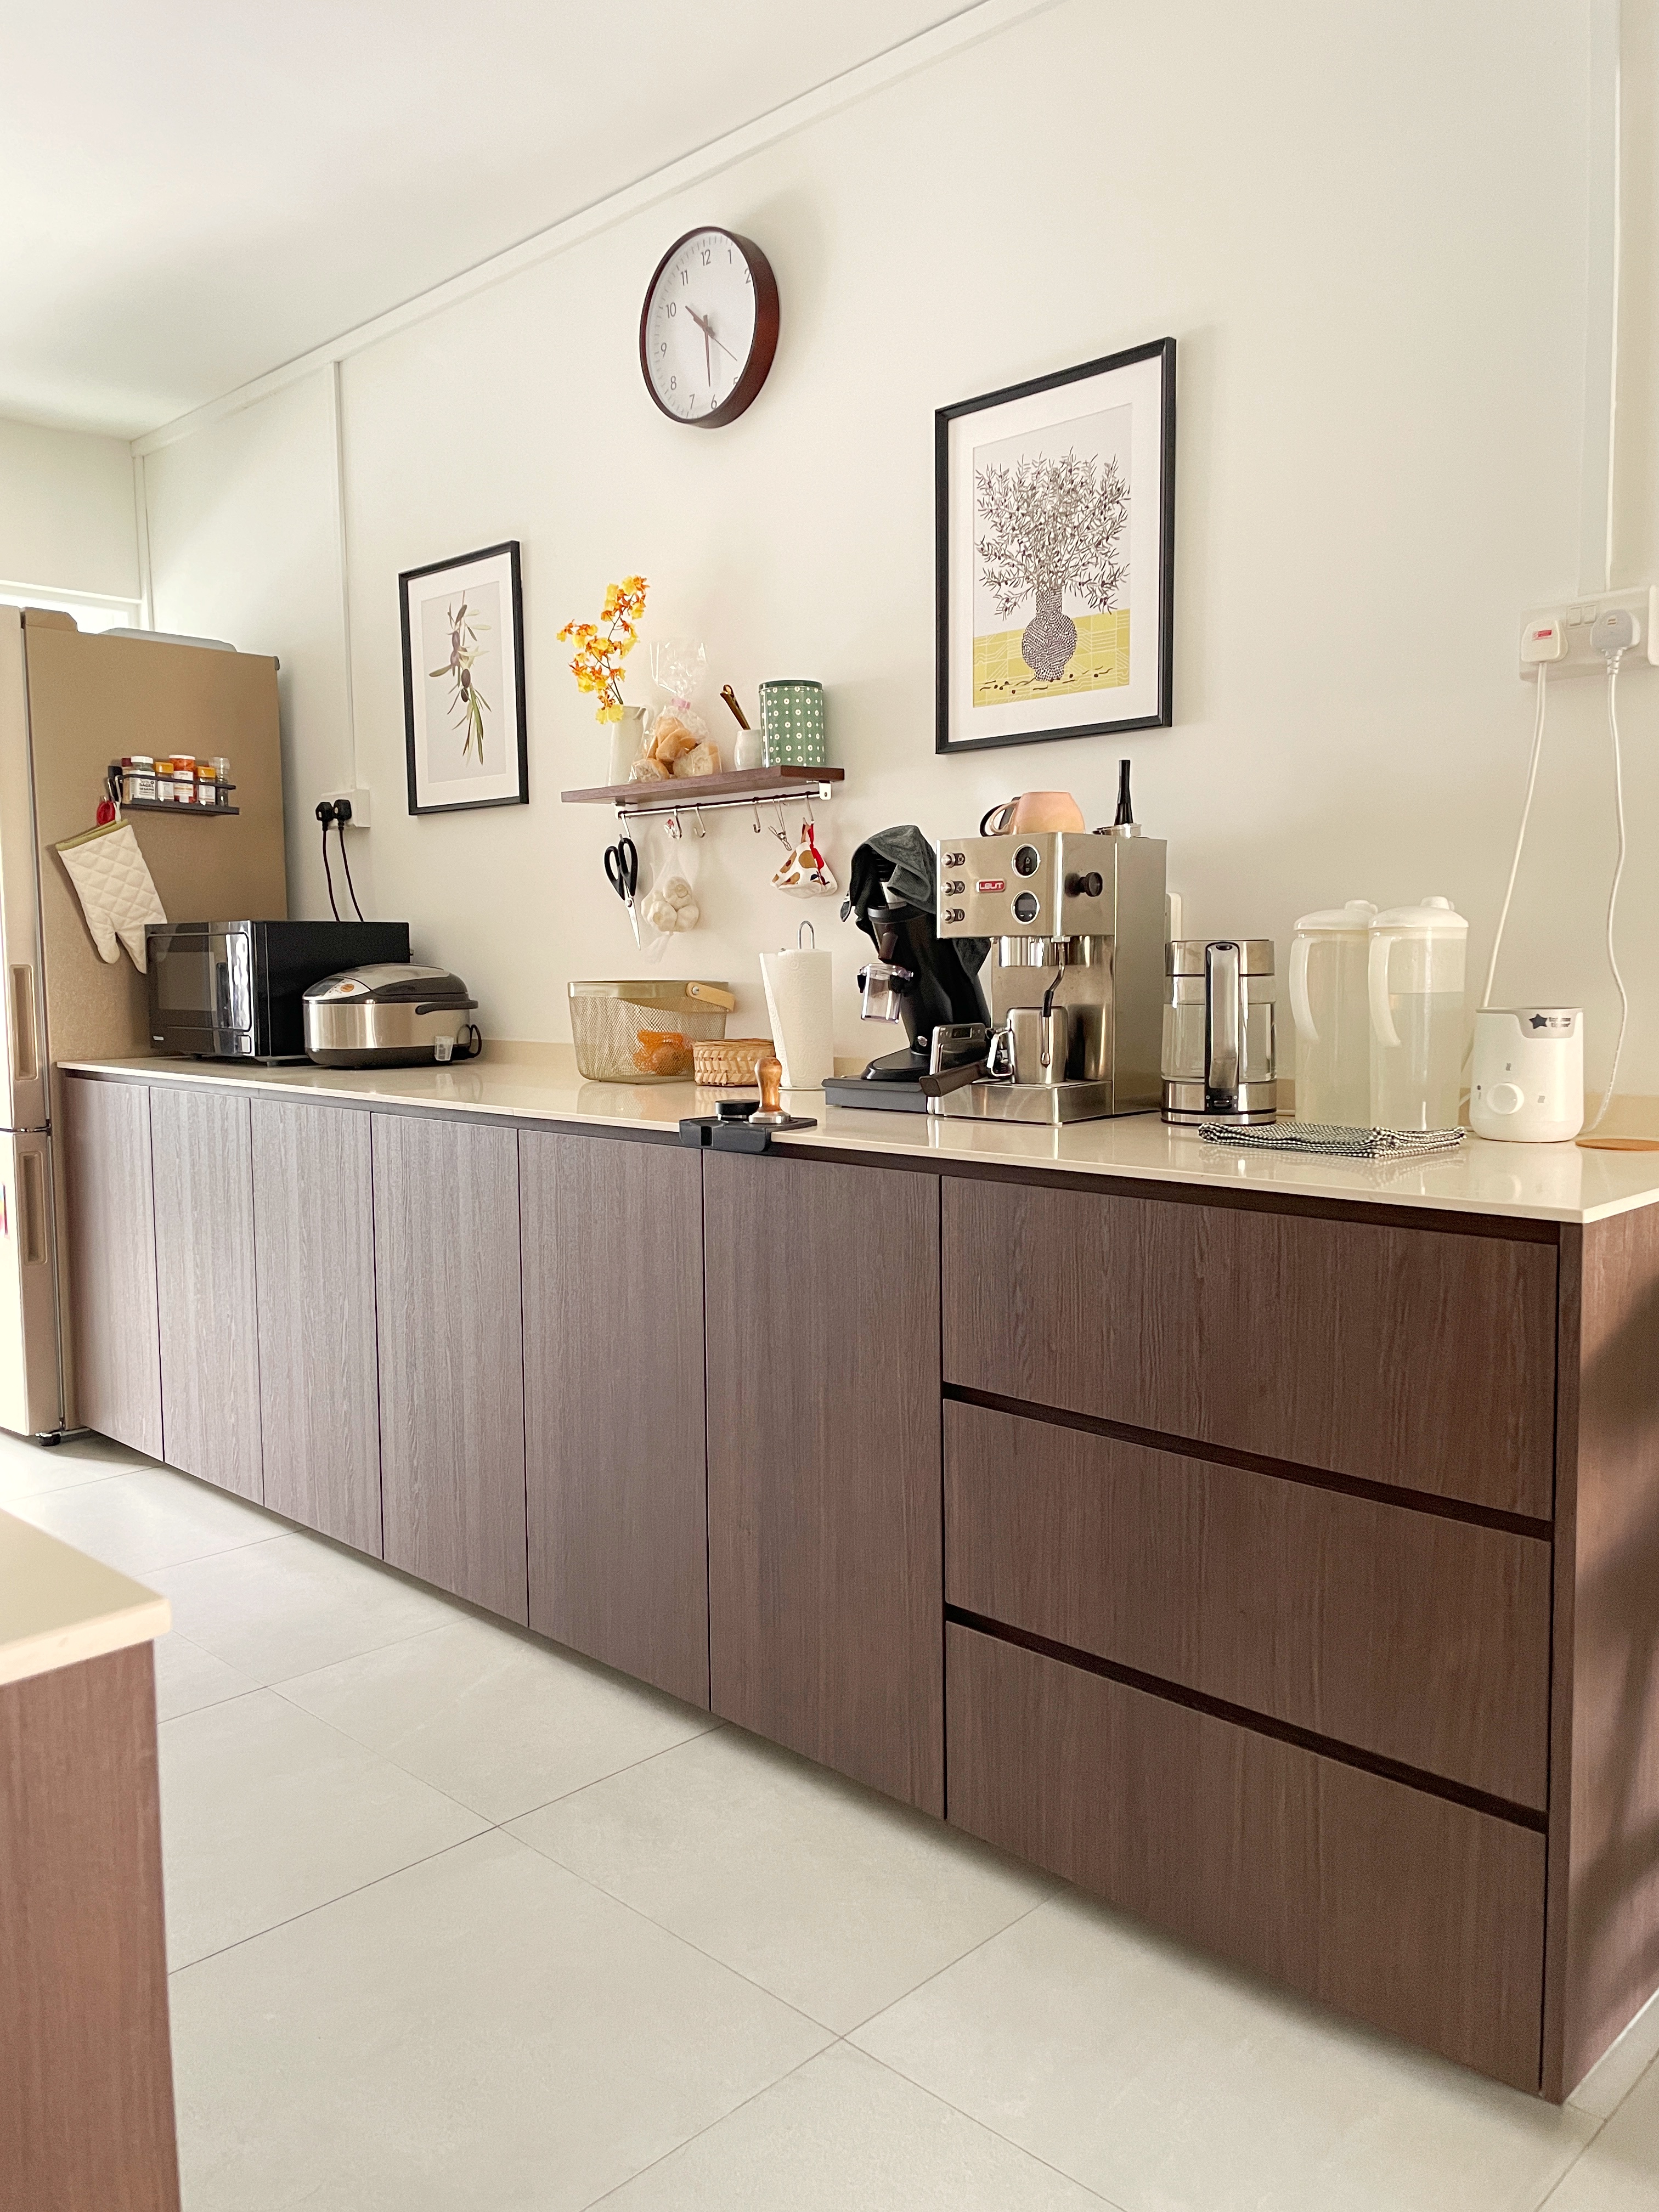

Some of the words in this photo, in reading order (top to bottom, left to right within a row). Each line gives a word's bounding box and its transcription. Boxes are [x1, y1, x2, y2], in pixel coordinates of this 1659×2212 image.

[701, 249, 711, 266] 12
[727, 249, 732, 264] 1
[681, 270, 689, 286] 11
[744, 268, 752, 284] 2
[666, 302, 676, 319] 10
[661, 342, 667, 358] 9
[670, 375, 677, 391] 8
[689, 393, 695, 410] 7
[710, 394, 717, 409] 6
